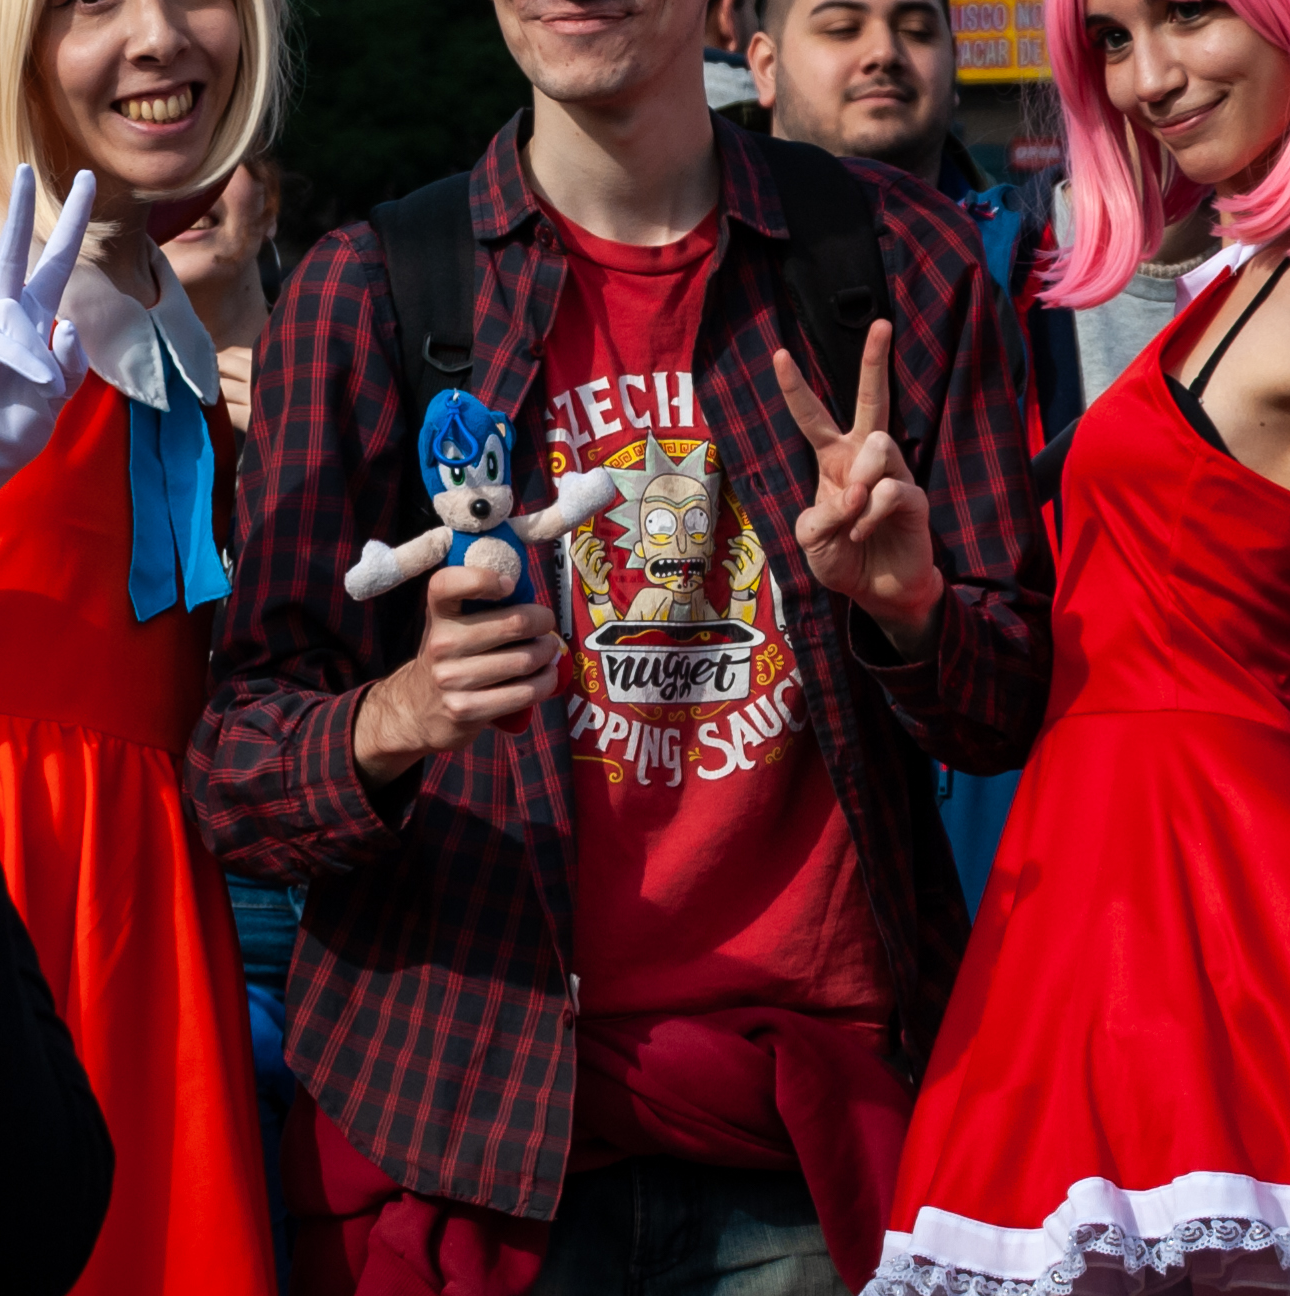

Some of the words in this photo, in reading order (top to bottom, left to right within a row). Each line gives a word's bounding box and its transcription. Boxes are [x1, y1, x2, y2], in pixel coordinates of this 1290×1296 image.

[957, 39, 1010, 66] ACAR
[605, 652, 750, 700] nugget
[697, 668, 807, 779] SAUC
